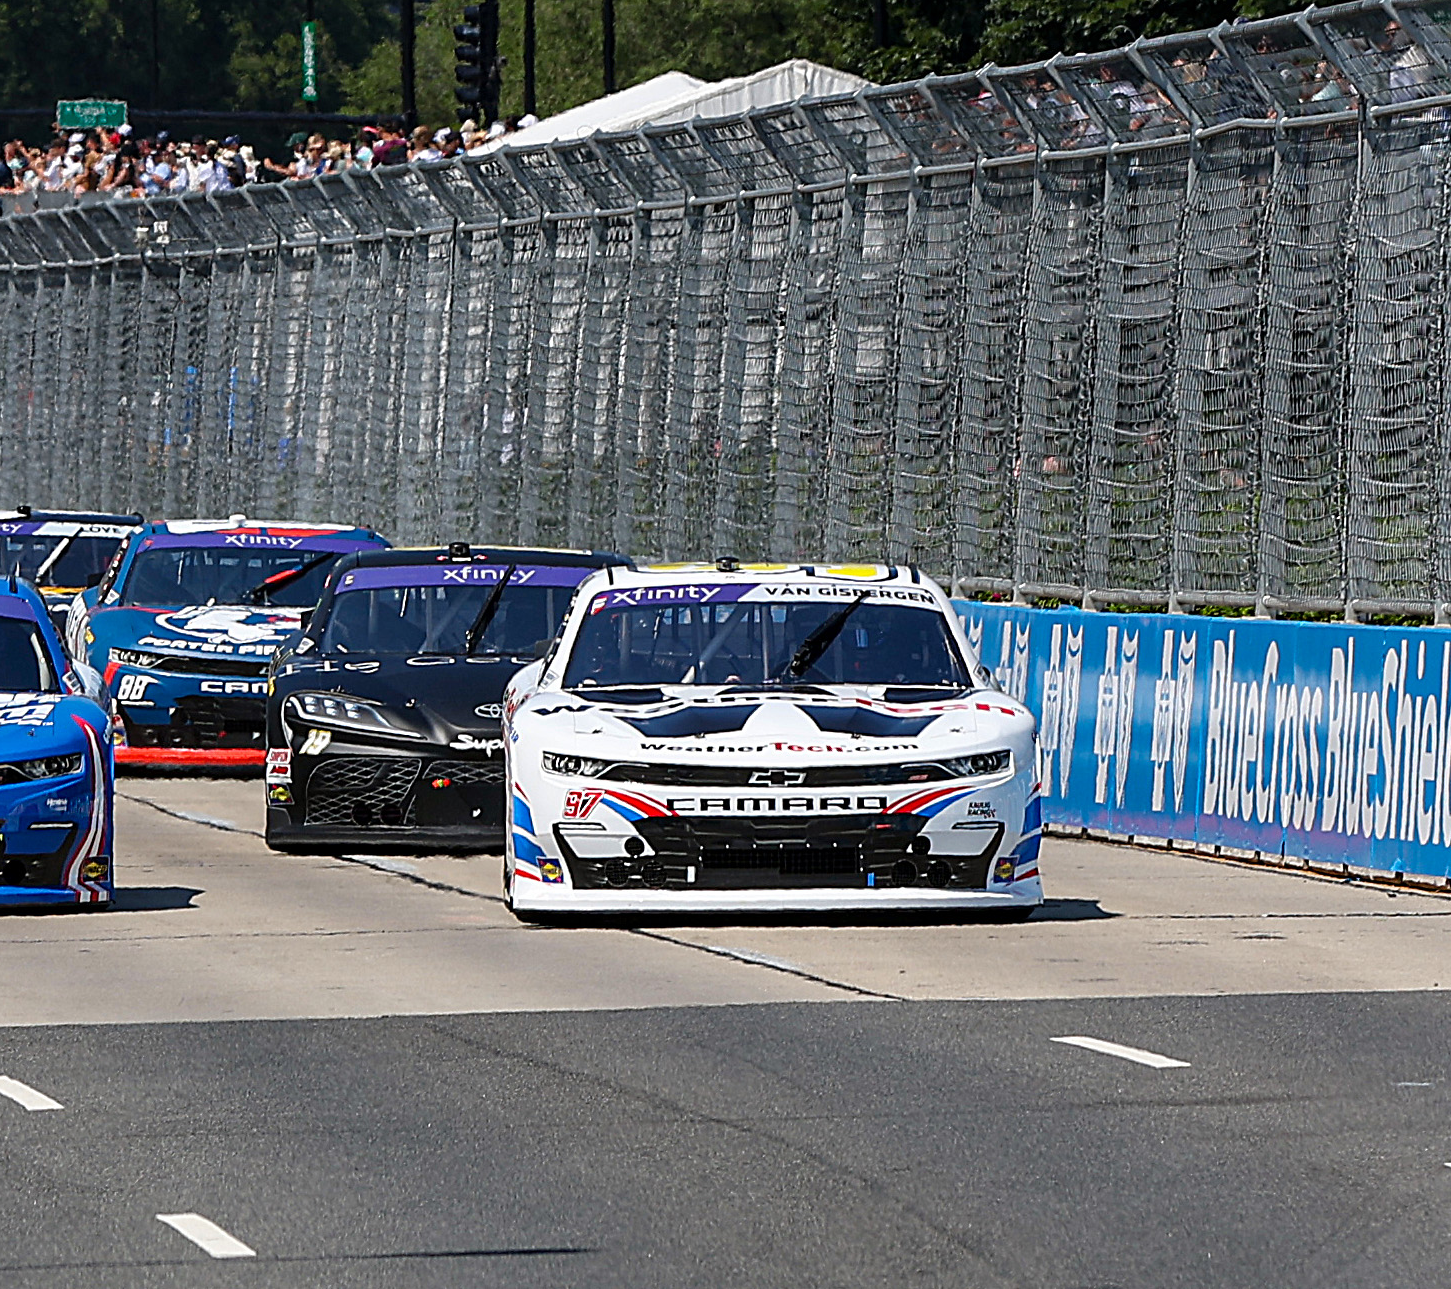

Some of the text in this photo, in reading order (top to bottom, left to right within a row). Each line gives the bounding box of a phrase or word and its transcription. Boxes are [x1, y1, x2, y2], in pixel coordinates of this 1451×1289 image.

[225, 534, 303, 549] xfinity
[612, 585, 721, 605] xfinity
[764, 586, 811, 597] VAN
[137, 636, 234, 654] PORTER
[118, 675, 149, 700] 88
[1203, 630, 1322, 831] BlueCross
[299, 729, 332, 755] 19
[640, 741, 919, 753] WeatherTech.com
[563, 789, 605, 819] 97
[667, 796, 888, 813] CAMARO
